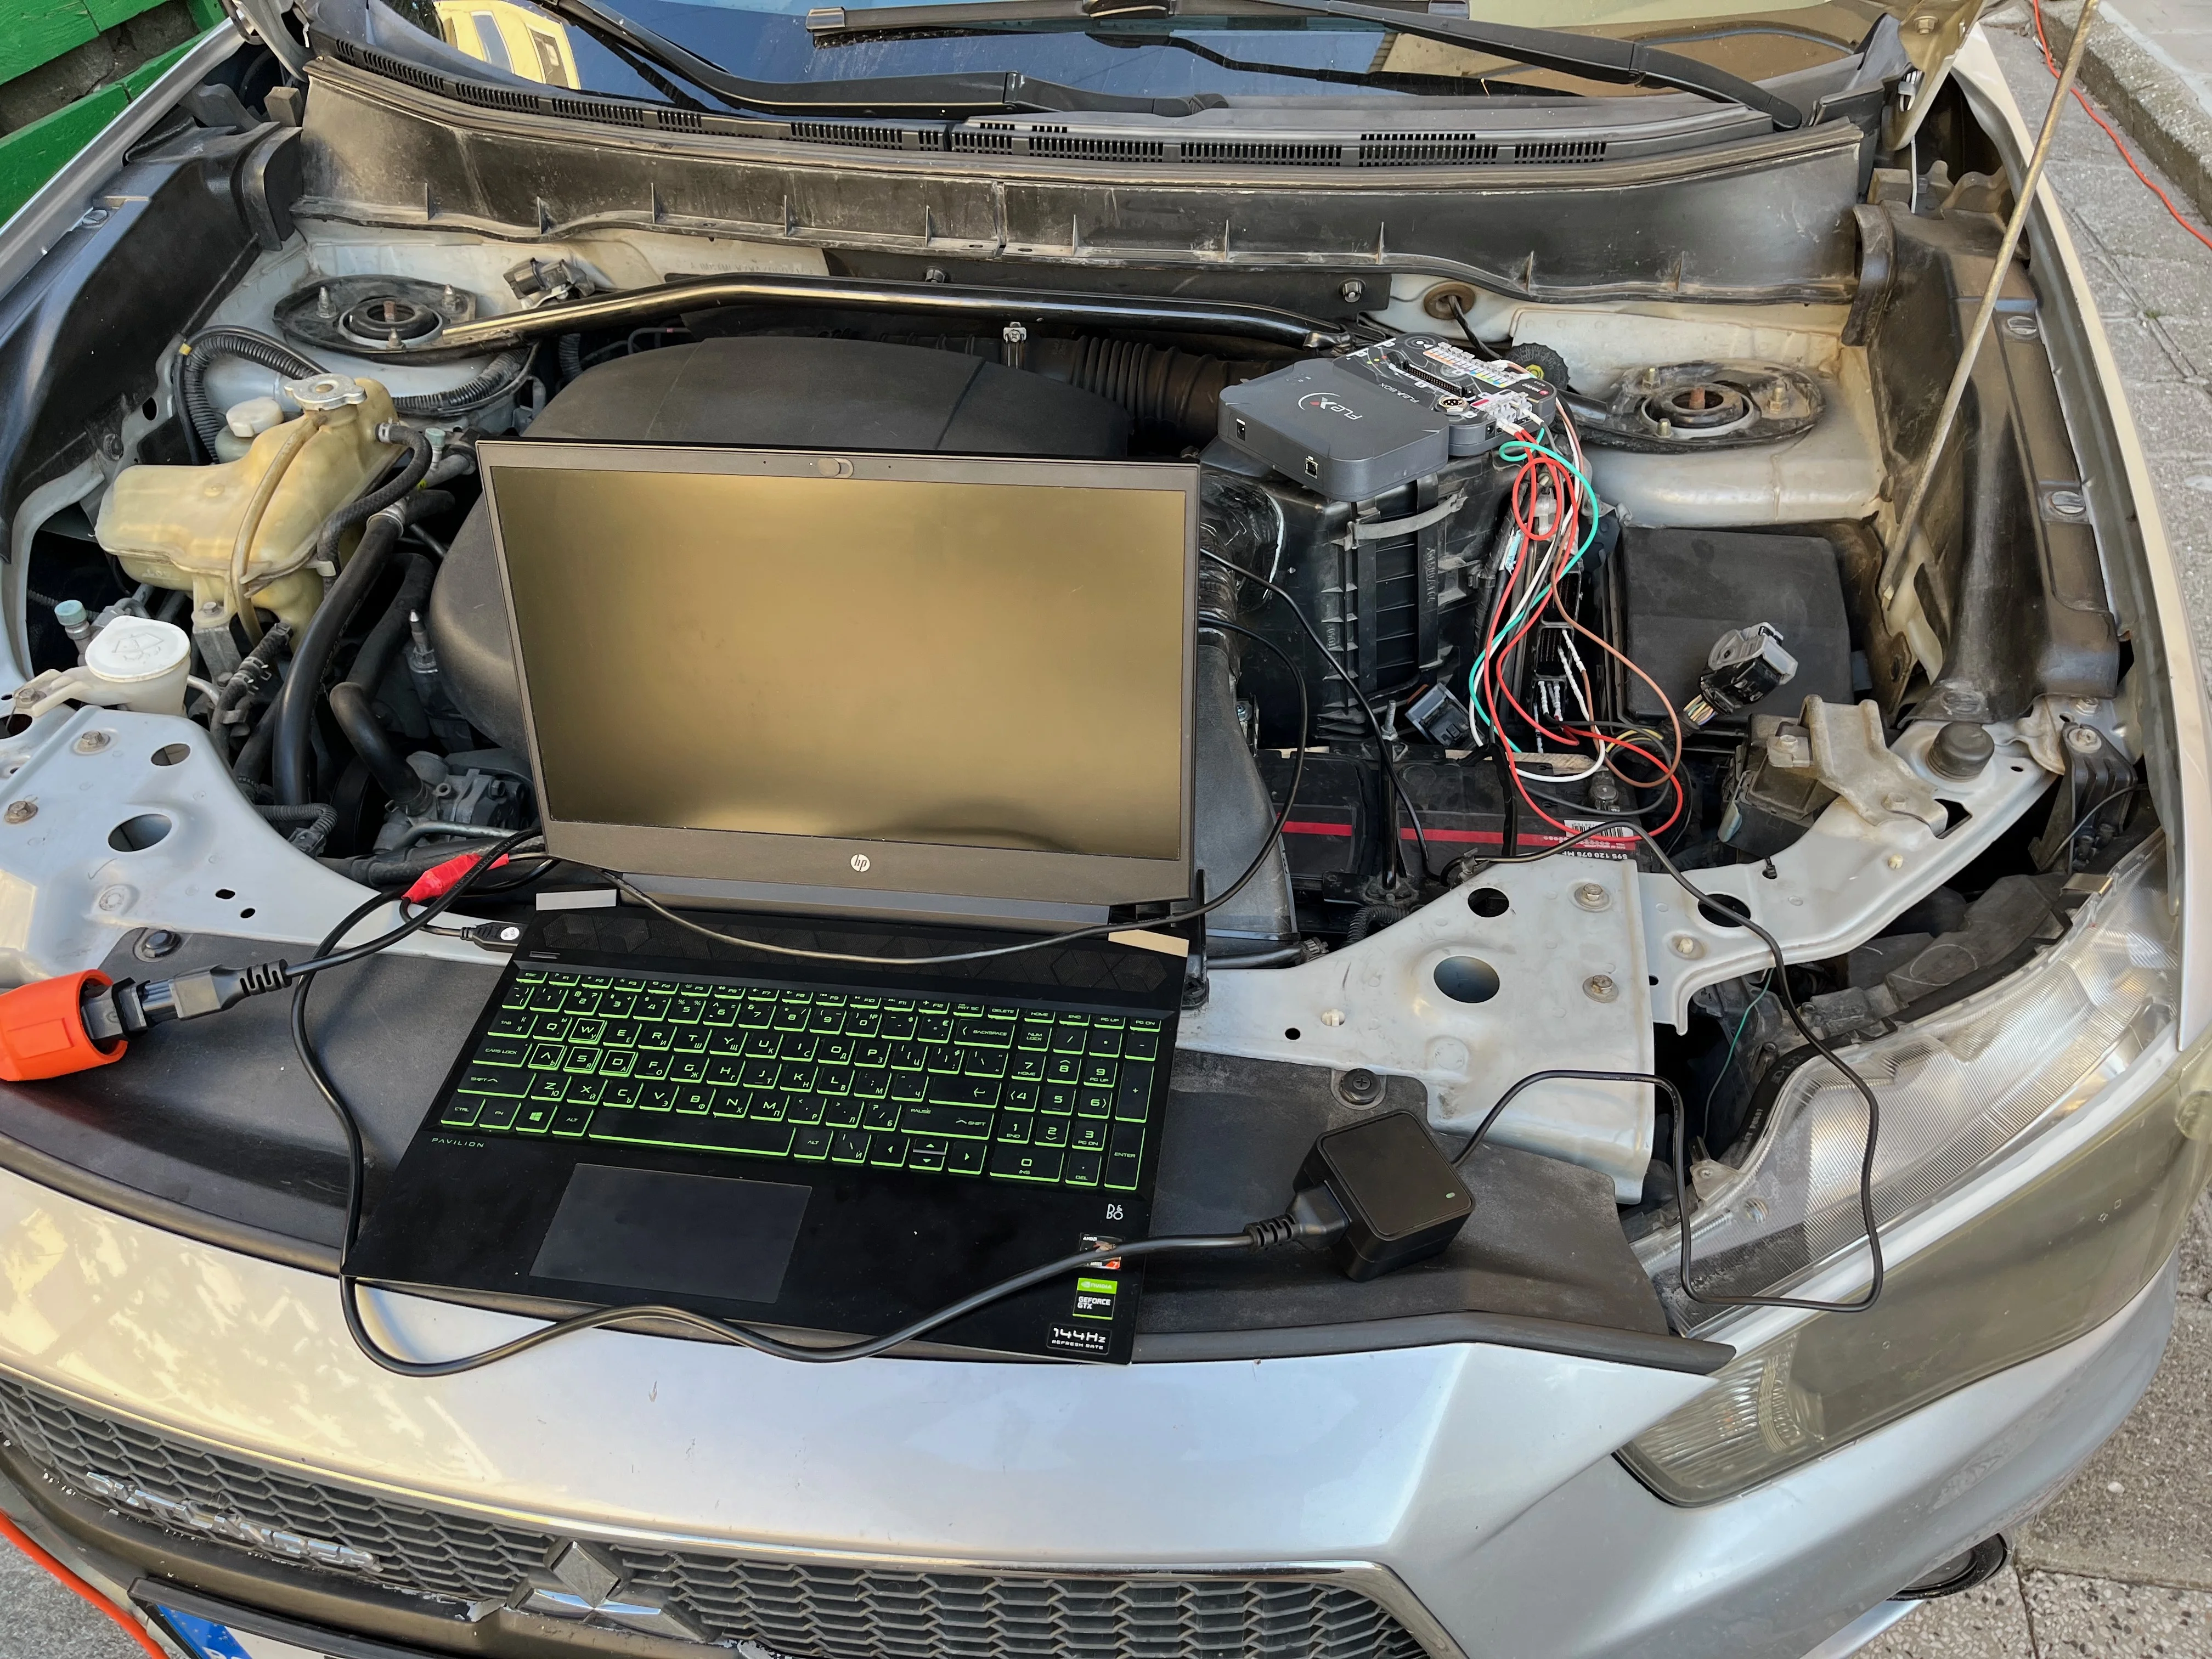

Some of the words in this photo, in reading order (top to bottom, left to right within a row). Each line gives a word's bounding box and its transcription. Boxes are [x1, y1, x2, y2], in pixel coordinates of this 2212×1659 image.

[853, 854, 868, 872] hp
[432, 1138, 484, 1147] PAVILION
[1078, 1296, 1111, 1306] GEFORCE
[1053, 1328, 1106, 1343] 144Hz
